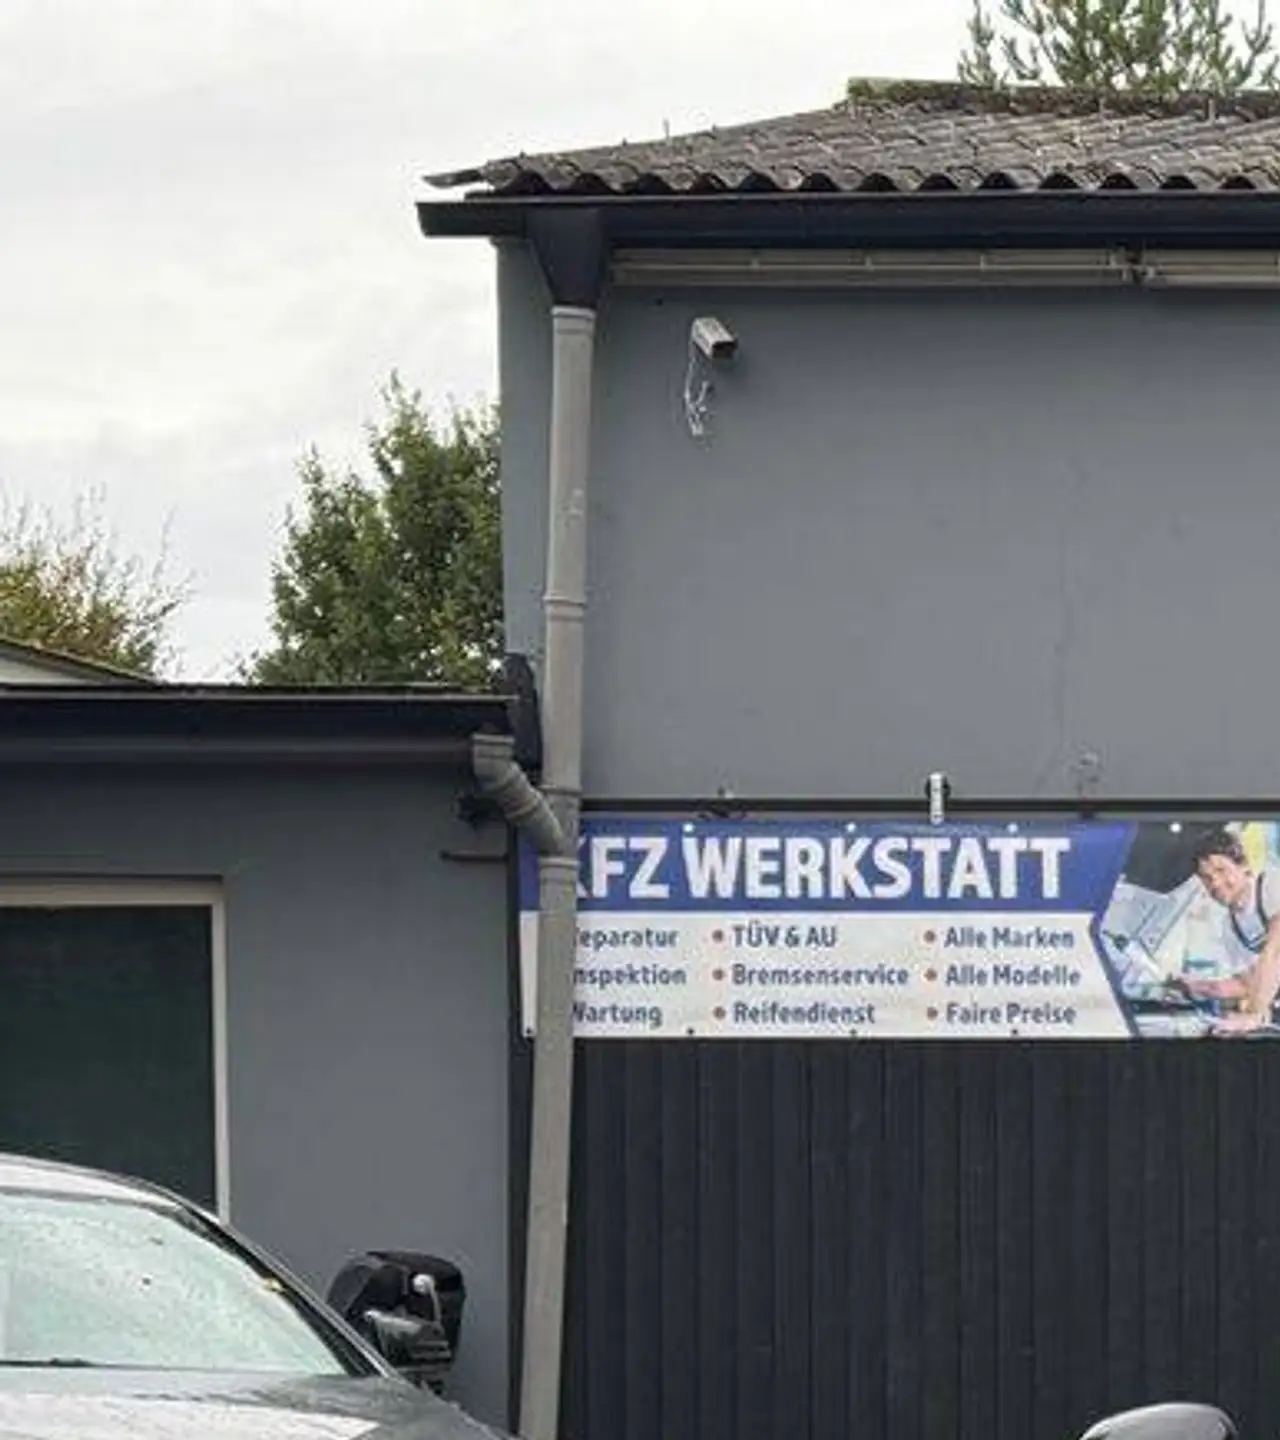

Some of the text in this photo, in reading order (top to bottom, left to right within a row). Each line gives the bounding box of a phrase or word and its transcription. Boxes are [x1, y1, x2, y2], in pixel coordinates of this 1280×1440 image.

[577, 836, 1070, 899] FZ WERKSTATT
[575, 927, 679, 952] eparatur
[732, 920, 837, 948] TÜV & AU
[944, 926, 1075, 948] Alle Marken
[573, 963, 688, 991] nspektion
[732, 962, 909, 986] Bremsenservice
[945, 963, 1082, 986] Alle Modelle
[733, 1001, 877, 1025] Reifendienst
[945, 1001, 1078, 1025] Faire Preise
